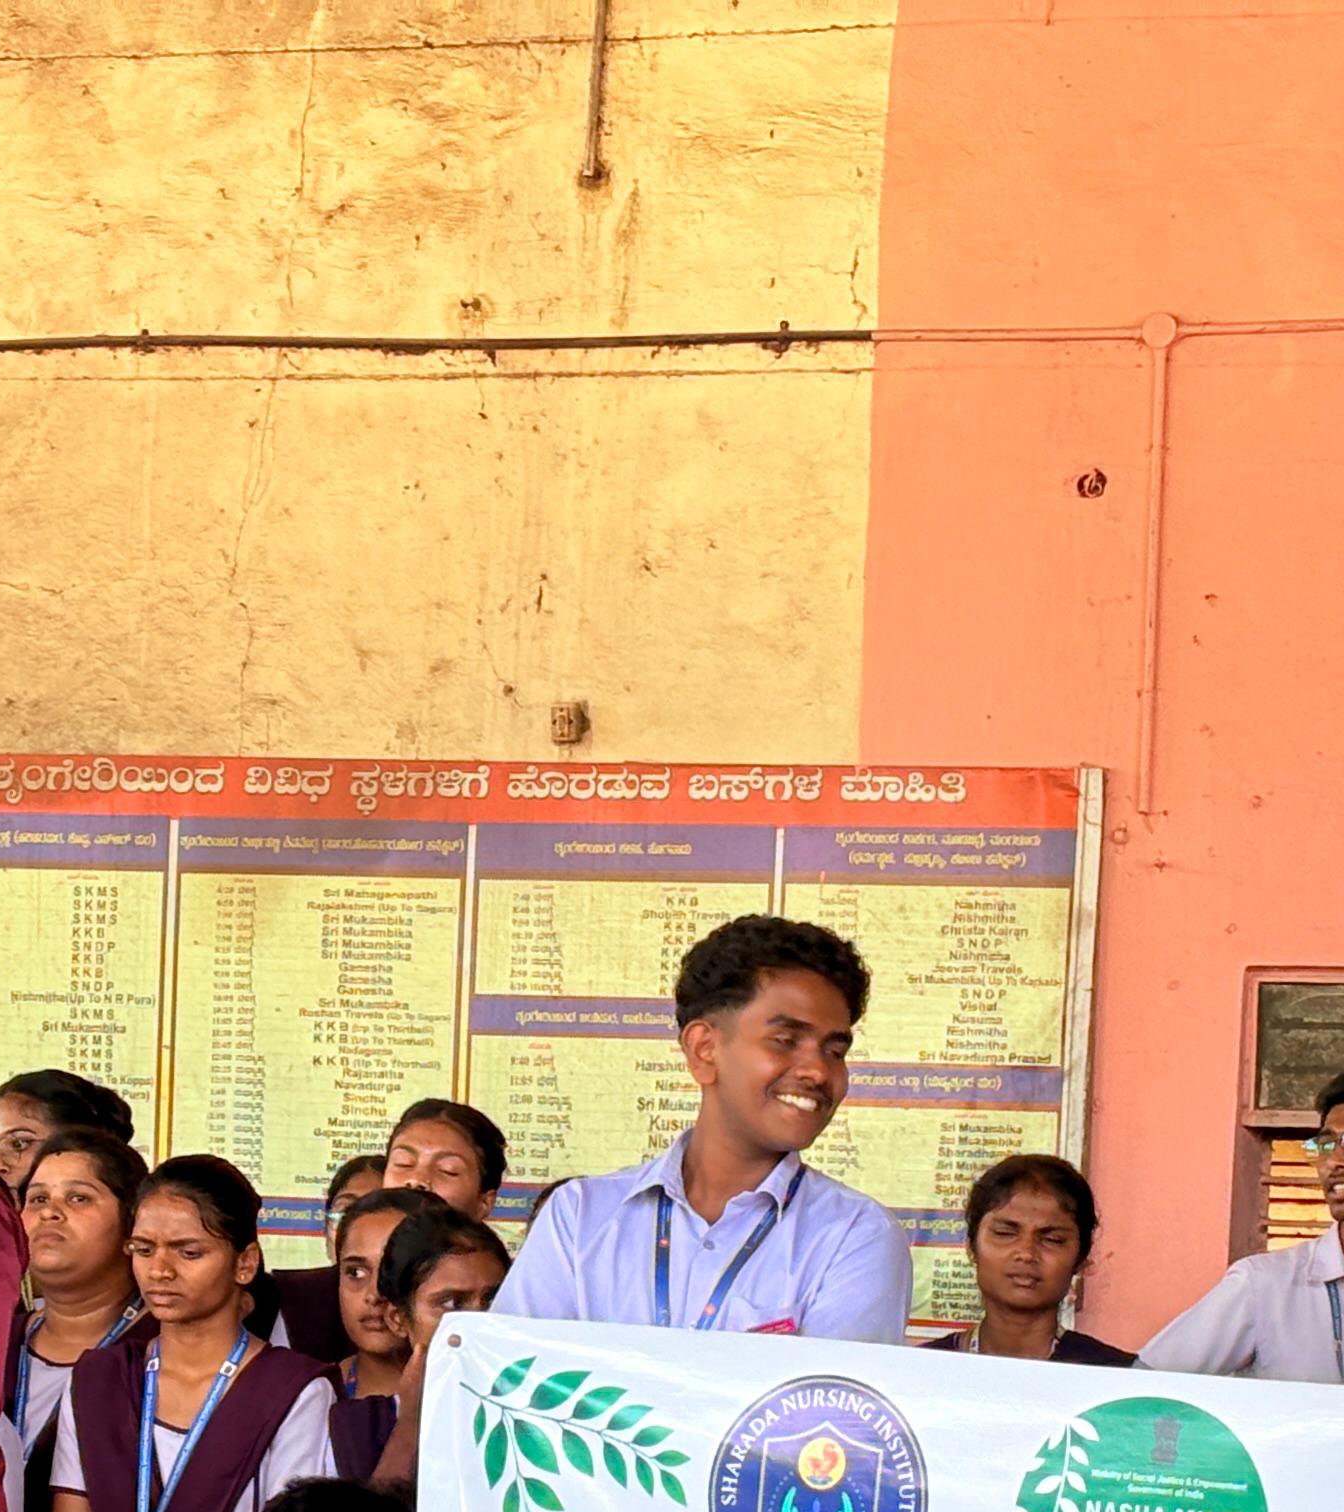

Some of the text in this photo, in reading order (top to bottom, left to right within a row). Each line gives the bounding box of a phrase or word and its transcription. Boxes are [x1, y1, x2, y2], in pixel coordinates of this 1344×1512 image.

[243, 761, 332, 804] ವಿವಿಧ
[349, 763, 490, 816] ಸ್ಥಳಗಳಿಗೆ
[507, 765, 670, 802] ಹೊರಡುವ
[839, 768, 968, 804] ಮಾಹಿತಿ
[343, 915, 413, 926] Mukambika
[720, 1408, 781, 1507] SHARADA
[778, 1387, 876, 1426] NURSING
